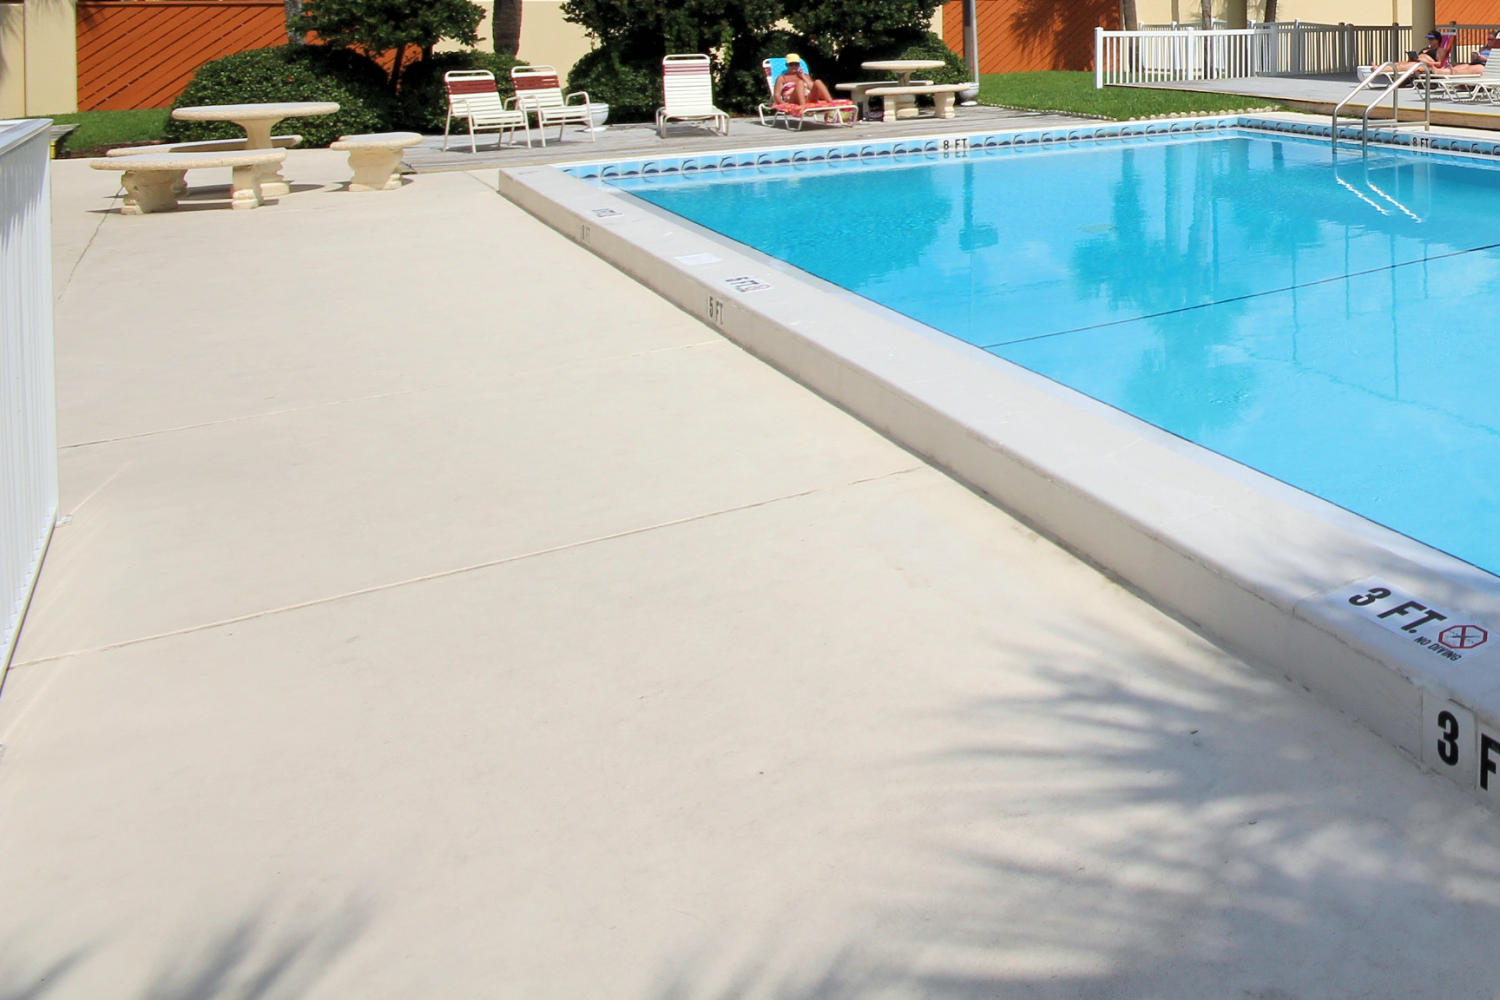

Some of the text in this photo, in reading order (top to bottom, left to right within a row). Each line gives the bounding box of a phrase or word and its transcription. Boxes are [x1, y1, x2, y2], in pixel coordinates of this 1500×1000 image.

[943, 138, 968, 150] 8 FT
[1420, 137, 1429, 148] FT
[1349, 587, 1447, 634] 3 FT.
[1414, 635, 1462, 661] NO DIVING
[1437, 710, 1459, 766] 3
